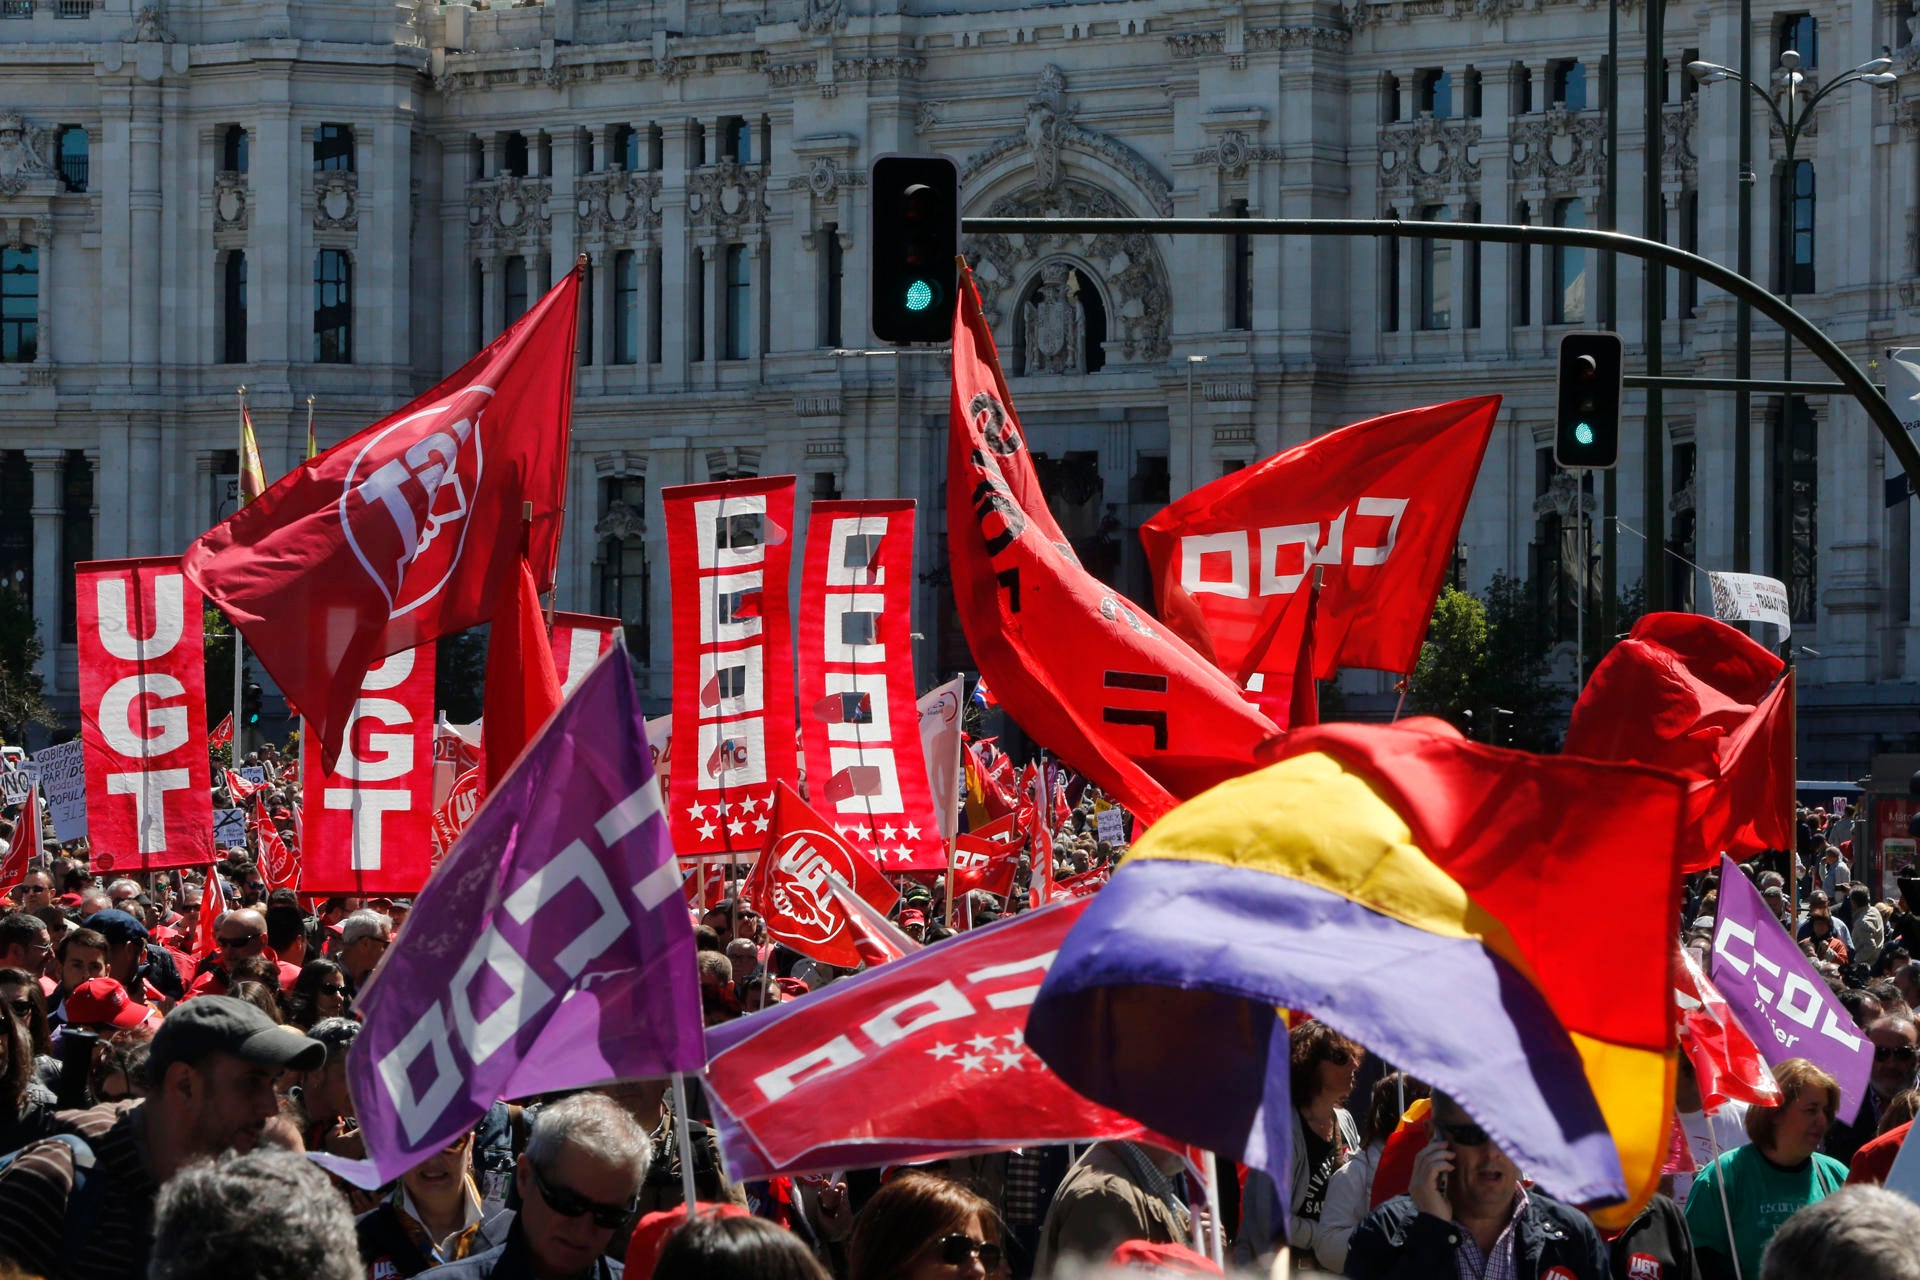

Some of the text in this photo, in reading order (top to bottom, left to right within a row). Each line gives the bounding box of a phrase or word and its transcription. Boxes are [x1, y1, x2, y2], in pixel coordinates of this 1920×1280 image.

[96, 573, 191, 854] UGT
[694, 495, 767, 791] CCOO
[823, 516, 905, 814] CCOO
[5, 771, 29, 796] NO
[40, 751, 84, 774] recortad
[1631, 1256, 1660, 1276] UGT
